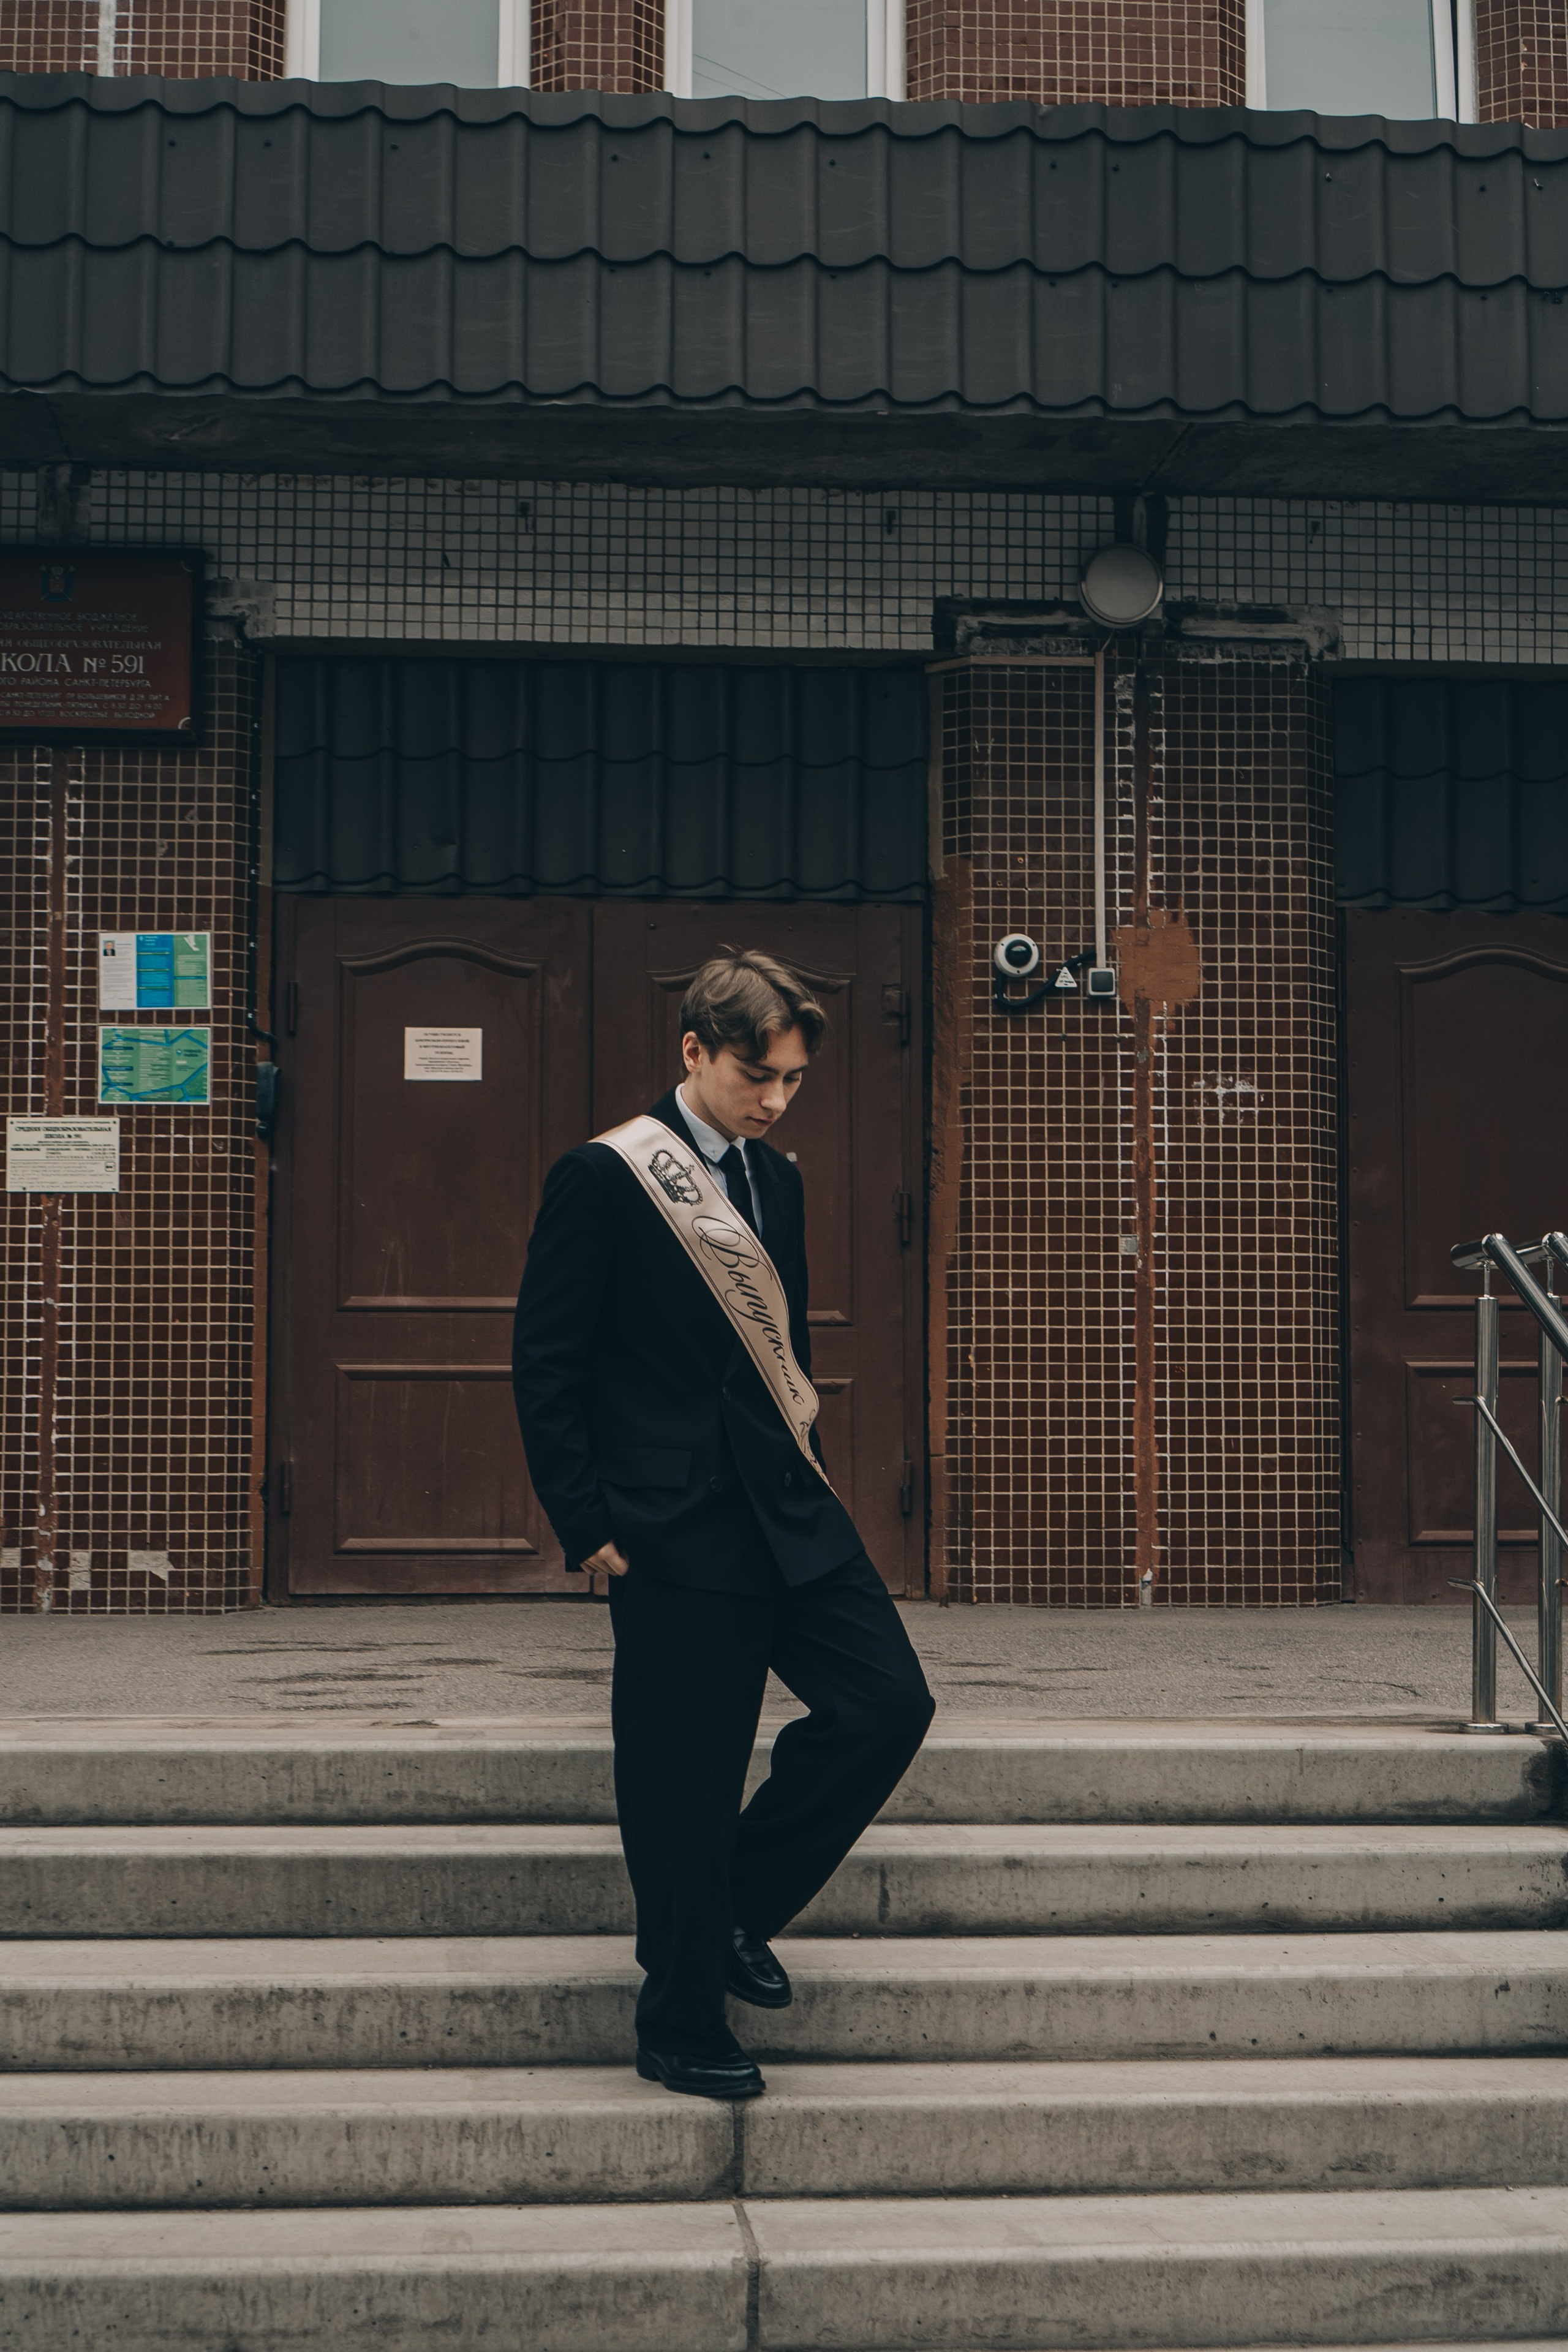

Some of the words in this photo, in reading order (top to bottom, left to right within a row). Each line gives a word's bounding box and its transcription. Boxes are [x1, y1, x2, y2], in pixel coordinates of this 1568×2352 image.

[17, 639, 162, 649] ОБЩЕОБРАЗОВАТЕЛЬНАЯ
[1, 653, 72, 673] КОЛА
[111, 654, 145, 674] 591
[20, 676, 59, 685] РАЙОНА
[64, 677, 151, 688] САНКТ-ПЕТЕРБУРГА
[692, 1215, 804, 1405] Выпускник
